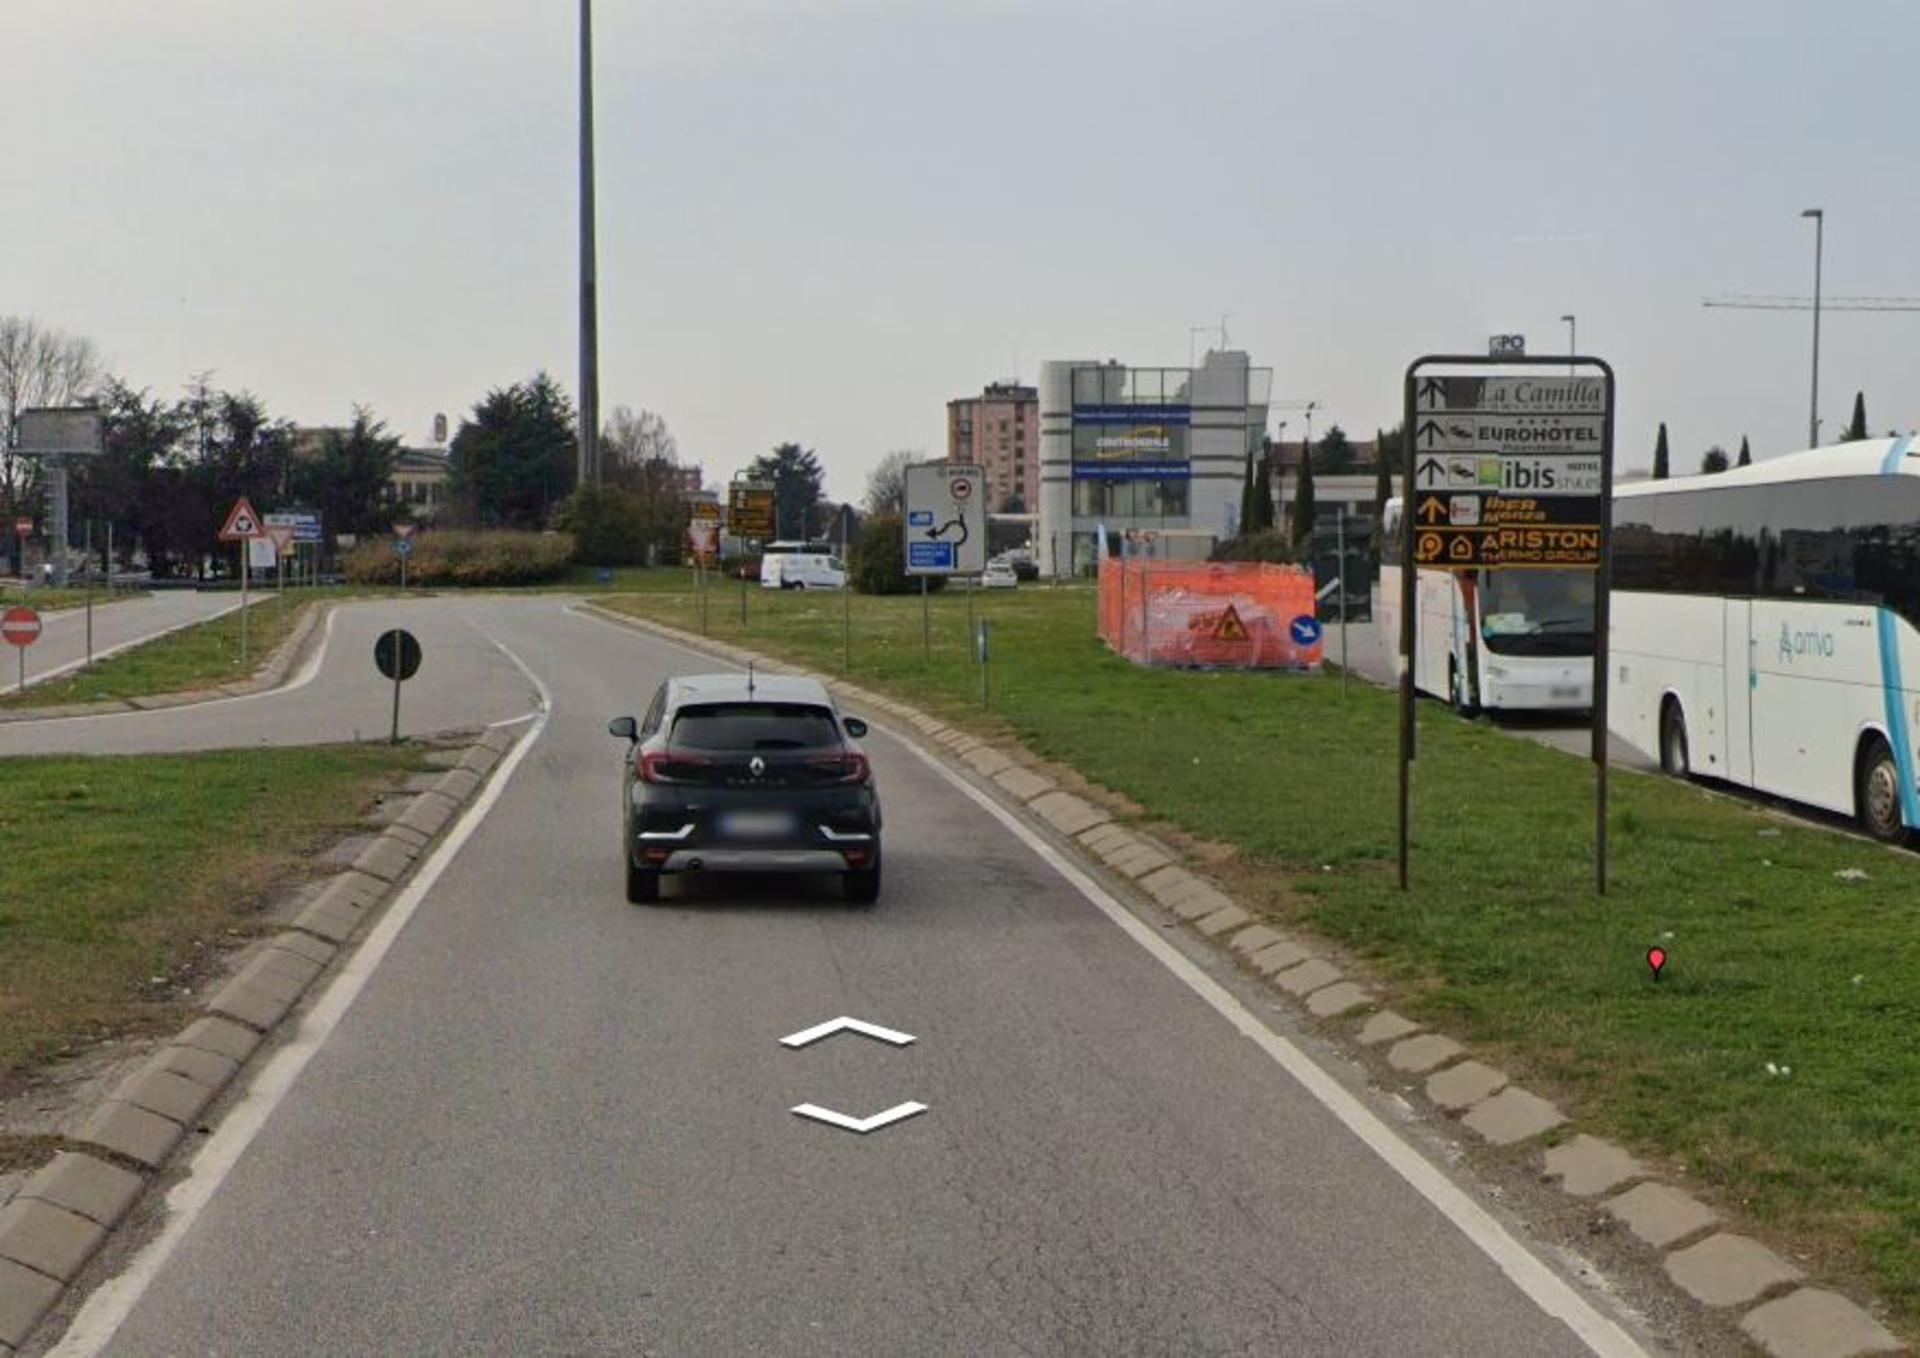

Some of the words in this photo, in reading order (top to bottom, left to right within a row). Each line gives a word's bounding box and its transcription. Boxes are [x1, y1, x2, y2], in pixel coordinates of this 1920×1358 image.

[1515, 381, 1601, 403] Camilla
[1478, 426, 1599, 442] EUROHOTEL
[1506, 461, 1556, 488] ibis
[1480, 530, 1598, 550] ARISTON
[1480, 550, 1543, 562] THERMO
[1545, 550, 1597, 561] GROUP
